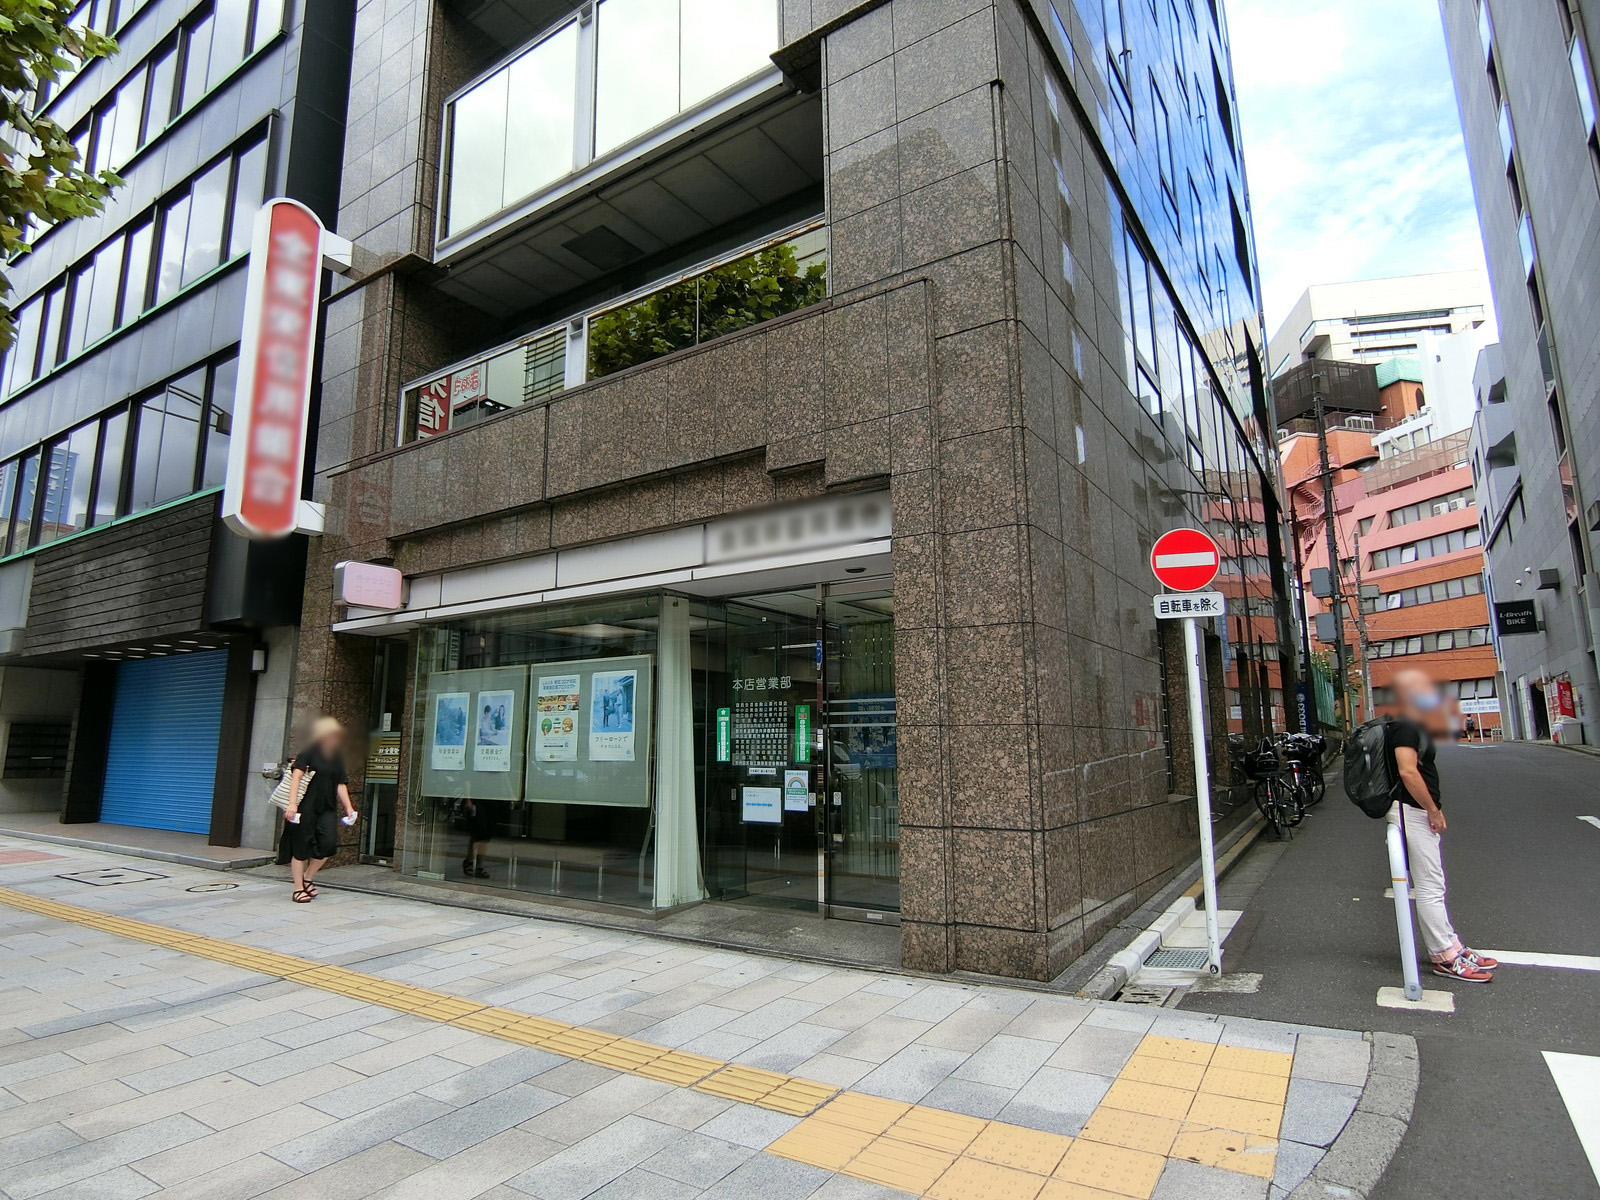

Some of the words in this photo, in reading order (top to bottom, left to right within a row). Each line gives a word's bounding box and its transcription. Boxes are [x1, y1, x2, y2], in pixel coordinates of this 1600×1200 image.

[1160, 598, 1219, 613] 自転車を除く
[1500, 610, 1533, 618] L-Breath
[1506, 617, 1527, 626] BIKE
[732, 675, 792, 691] 本店営業部
